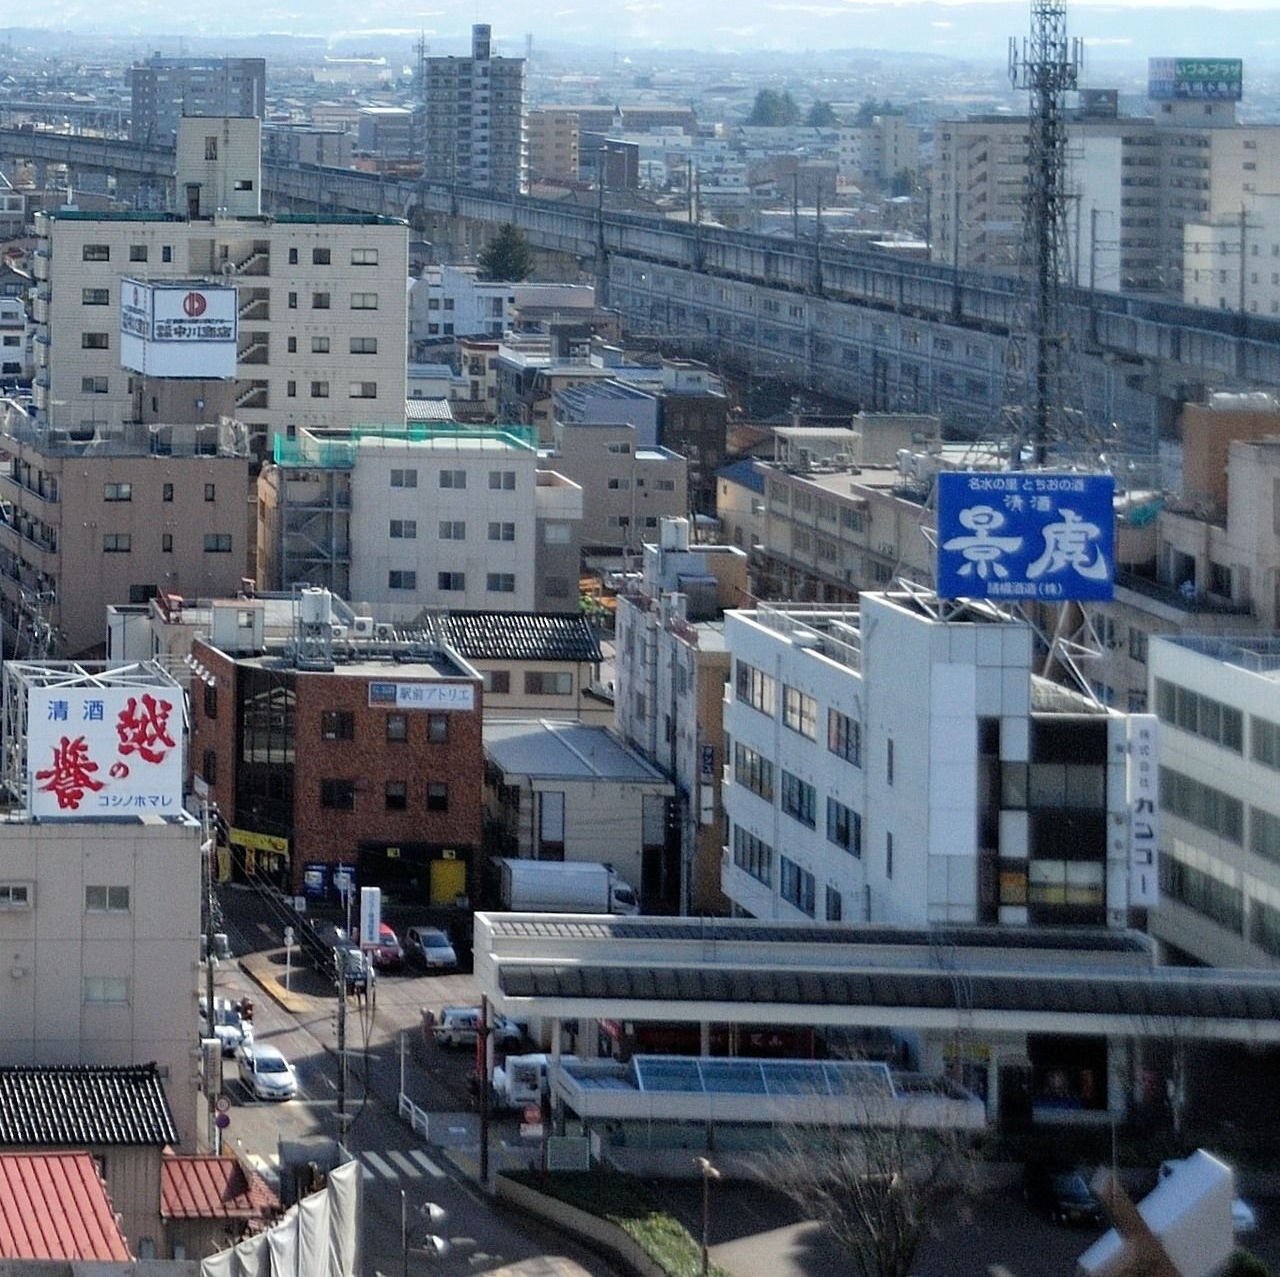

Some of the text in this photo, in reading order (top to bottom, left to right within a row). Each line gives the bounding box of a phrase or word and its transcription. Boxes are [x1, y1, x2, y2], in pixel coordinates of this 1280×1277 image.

[969, 478, 1084, 491] 名水の里 とちおの酒
[943, 505, 1108, 580] 景虎
[400, 687, 470, 701] 駅前アトリエ
[48, 700, 104, 721] 清酒
[99, 795, 173, 807] コシノホマレ
[1134, 797, 1154, 895] カンコー
